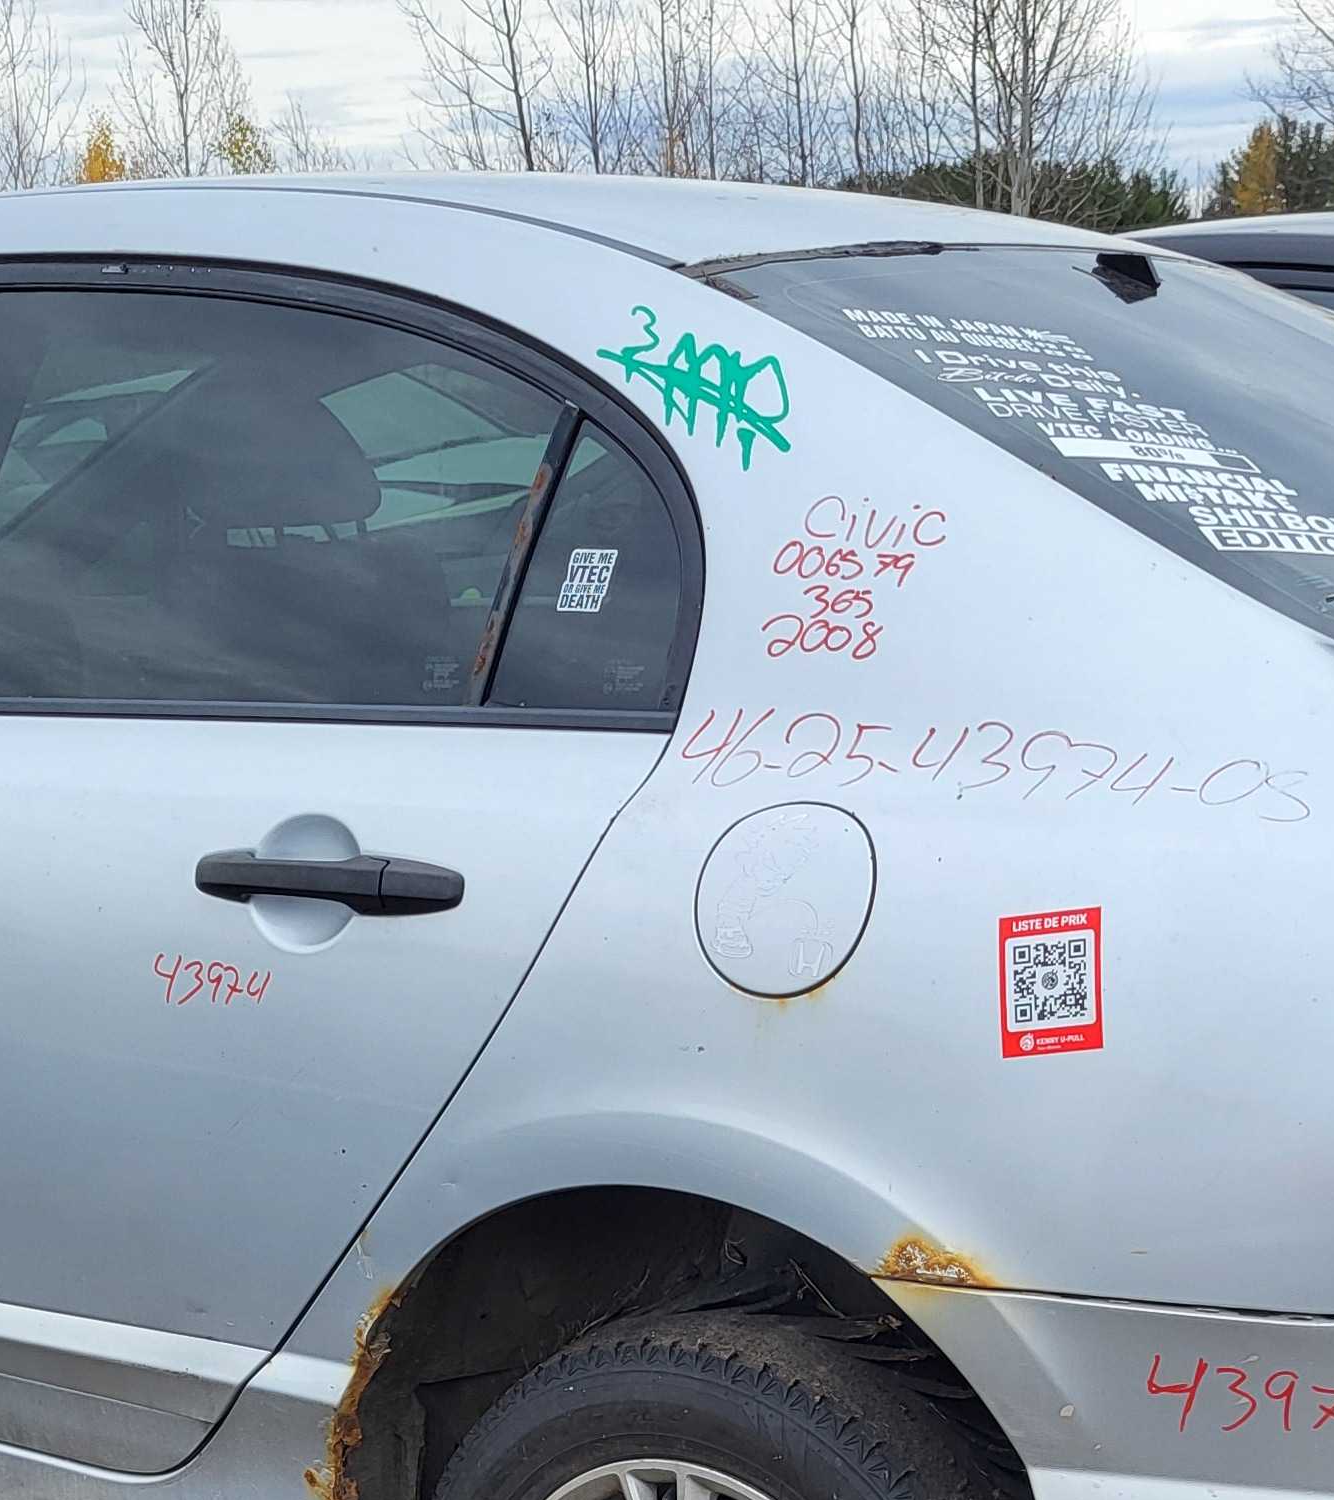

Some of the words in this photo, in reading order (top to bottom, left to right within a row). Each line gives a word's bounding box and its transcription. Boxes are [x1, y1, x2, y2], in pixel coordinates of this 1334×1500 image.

[842, 309, 917, 327] MADE
[914, 313, 946, 329] IN
[949, 318, 1024, 338] JAPAN
[858, 324, 927, 341] BATTU
[929, 329, 961, 344] AU
[960, 333, 1041, 353] QUEBEC
[914, 349, 932, 363] I
[934, 350, 1043, 373] Drive
[1047, 361, 1122, 383] this
[973, 386, 1080, 409] LIVE
[1084, 395, 1189, 422] FAST
[986, 402, 1090, 423] DRIVE
[1087, 409, 1210, 438] FASTER
[1037, 422, 1104, 439] VTEC
[1099, 462, 1299, 497] FINANCIAL
[572, 552, 596, 564] GIVE
[597, 552, 615, 564] ME
[562, 583, 574, 593] OR
[575, 584, 592, 594] GIVE
[592, 584, 606, 594] ME
[569, 565, 610, 584] VTEC
[558, 594, 600, 609] DEATH
[802, 584, 874, 619] 365
[761, 613, 884, 661] 2008
[1012, 917, 1043, 933] LISTE
[1043, 915, 1059, 929] DE
[1060, 912, 1088, 927] PRIX
[154, 952, 272, 1006] 43974
